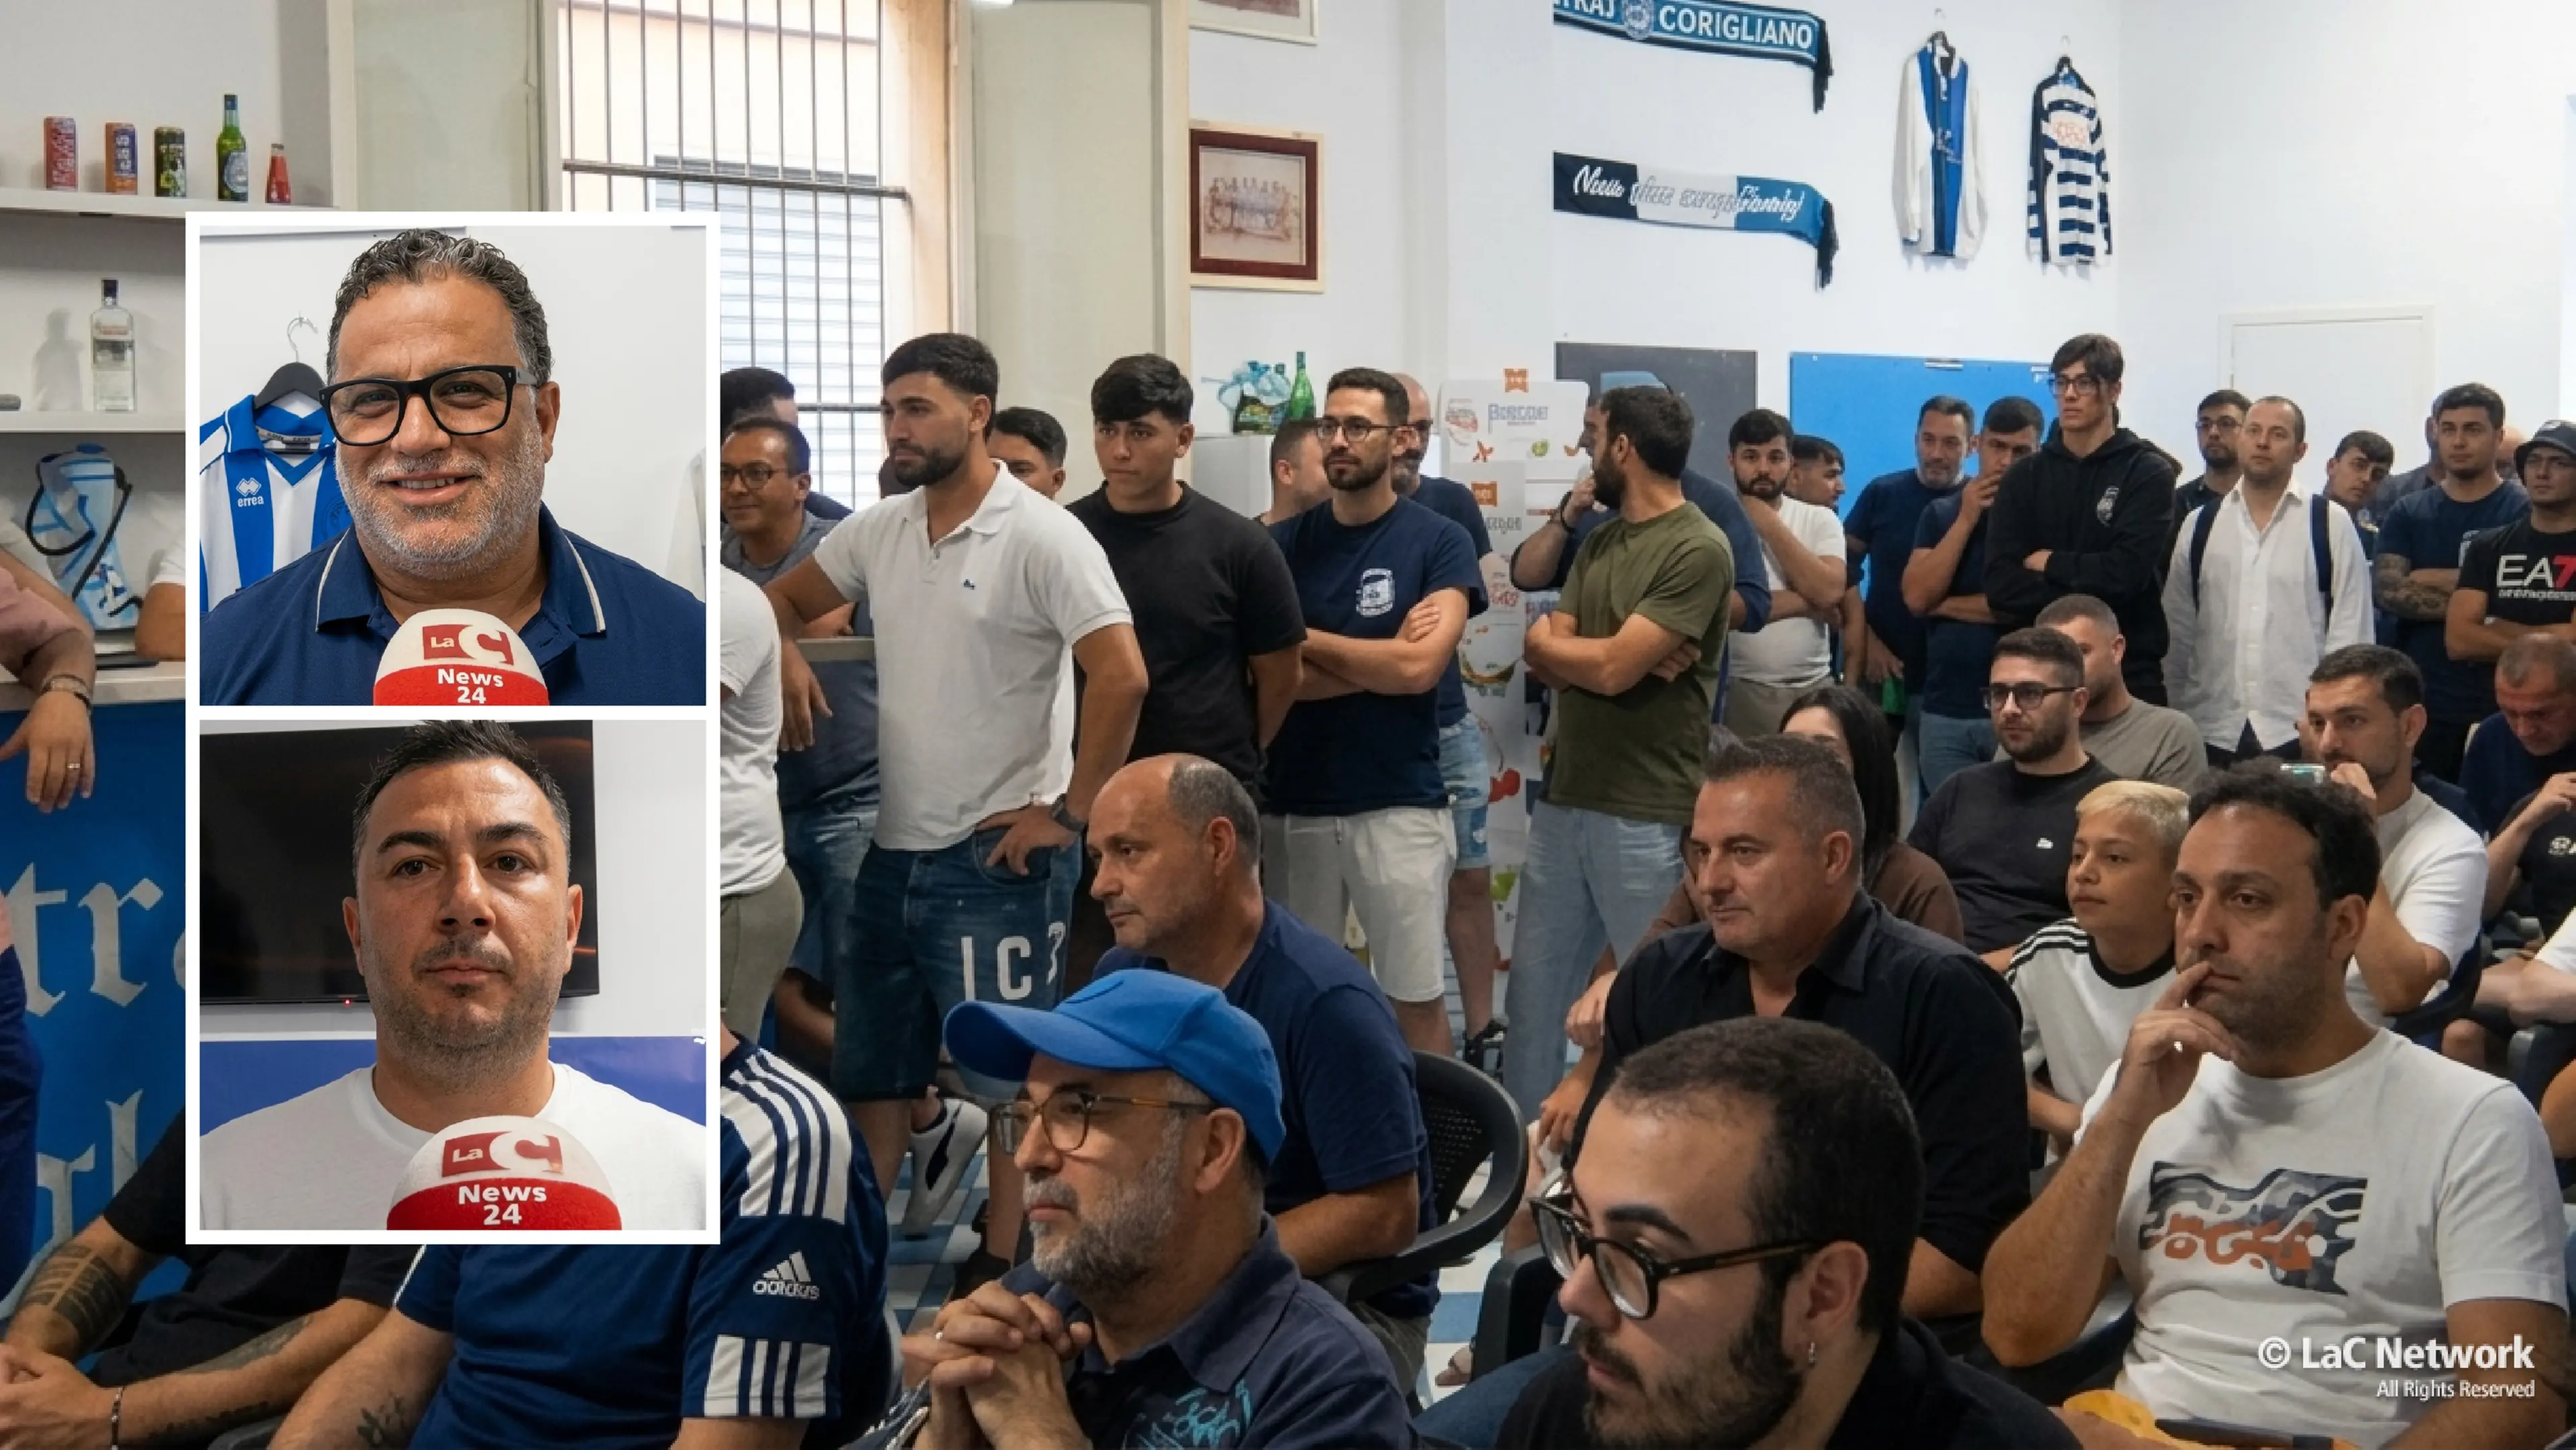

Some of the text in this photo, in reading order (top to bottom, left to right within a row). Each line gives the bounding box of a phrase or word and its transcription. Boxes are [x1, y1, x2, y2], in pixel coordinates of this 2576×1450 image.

[1659, 5, 1812, 49] CORIGLIANO
[2497, 555, 2576, 588] EA7
[437, 668, 503, 687] News
[457, 686, 486, 704] 24
[458, 1184, 547, 1204] News
[483, 1204, 522, 1225] 24
